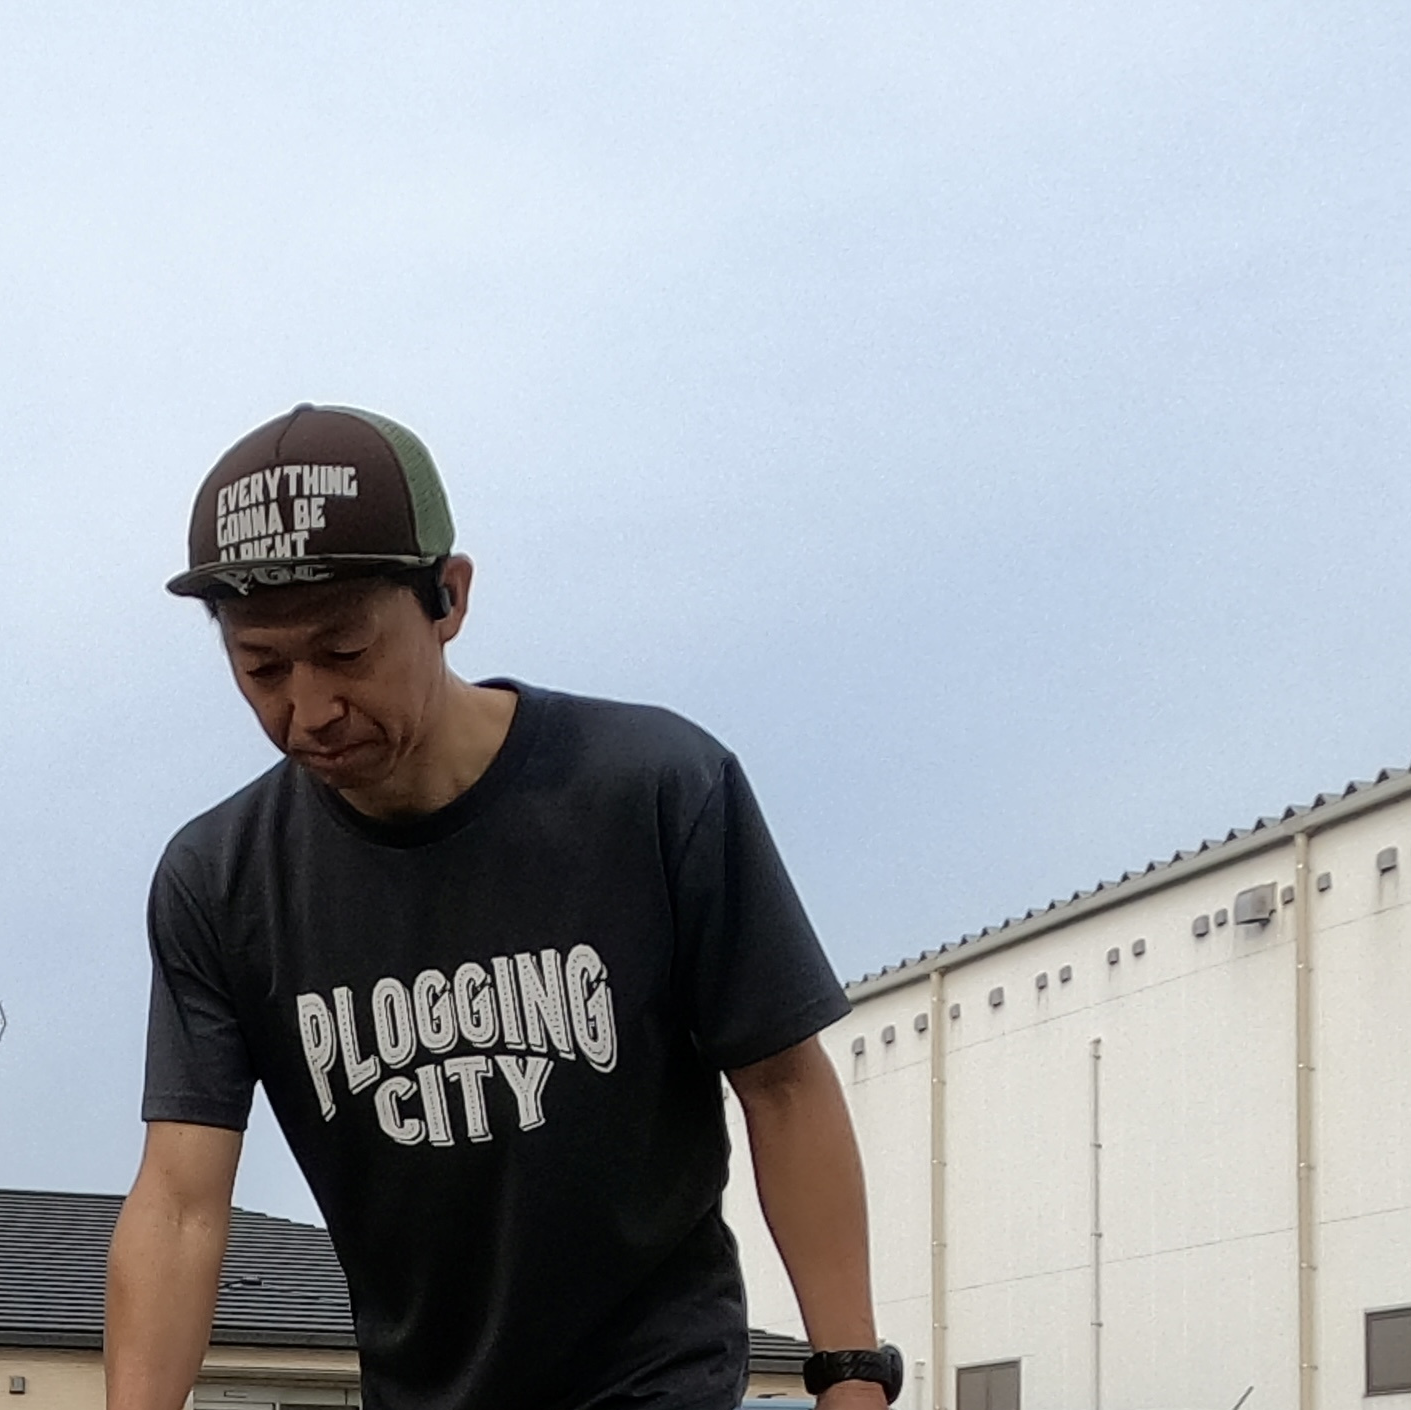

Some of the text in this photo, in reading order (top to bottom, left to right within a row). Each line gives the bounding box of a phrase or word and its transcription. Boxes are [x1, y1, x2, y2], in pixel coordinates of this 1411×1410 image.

[217, 464, 358, 517] EVERYTHING
[217, 497, 326, 548] GONNA BE
[296, 943, 617, 1121] PLOGGING
[373, 1055, 554, 1146] CITY
